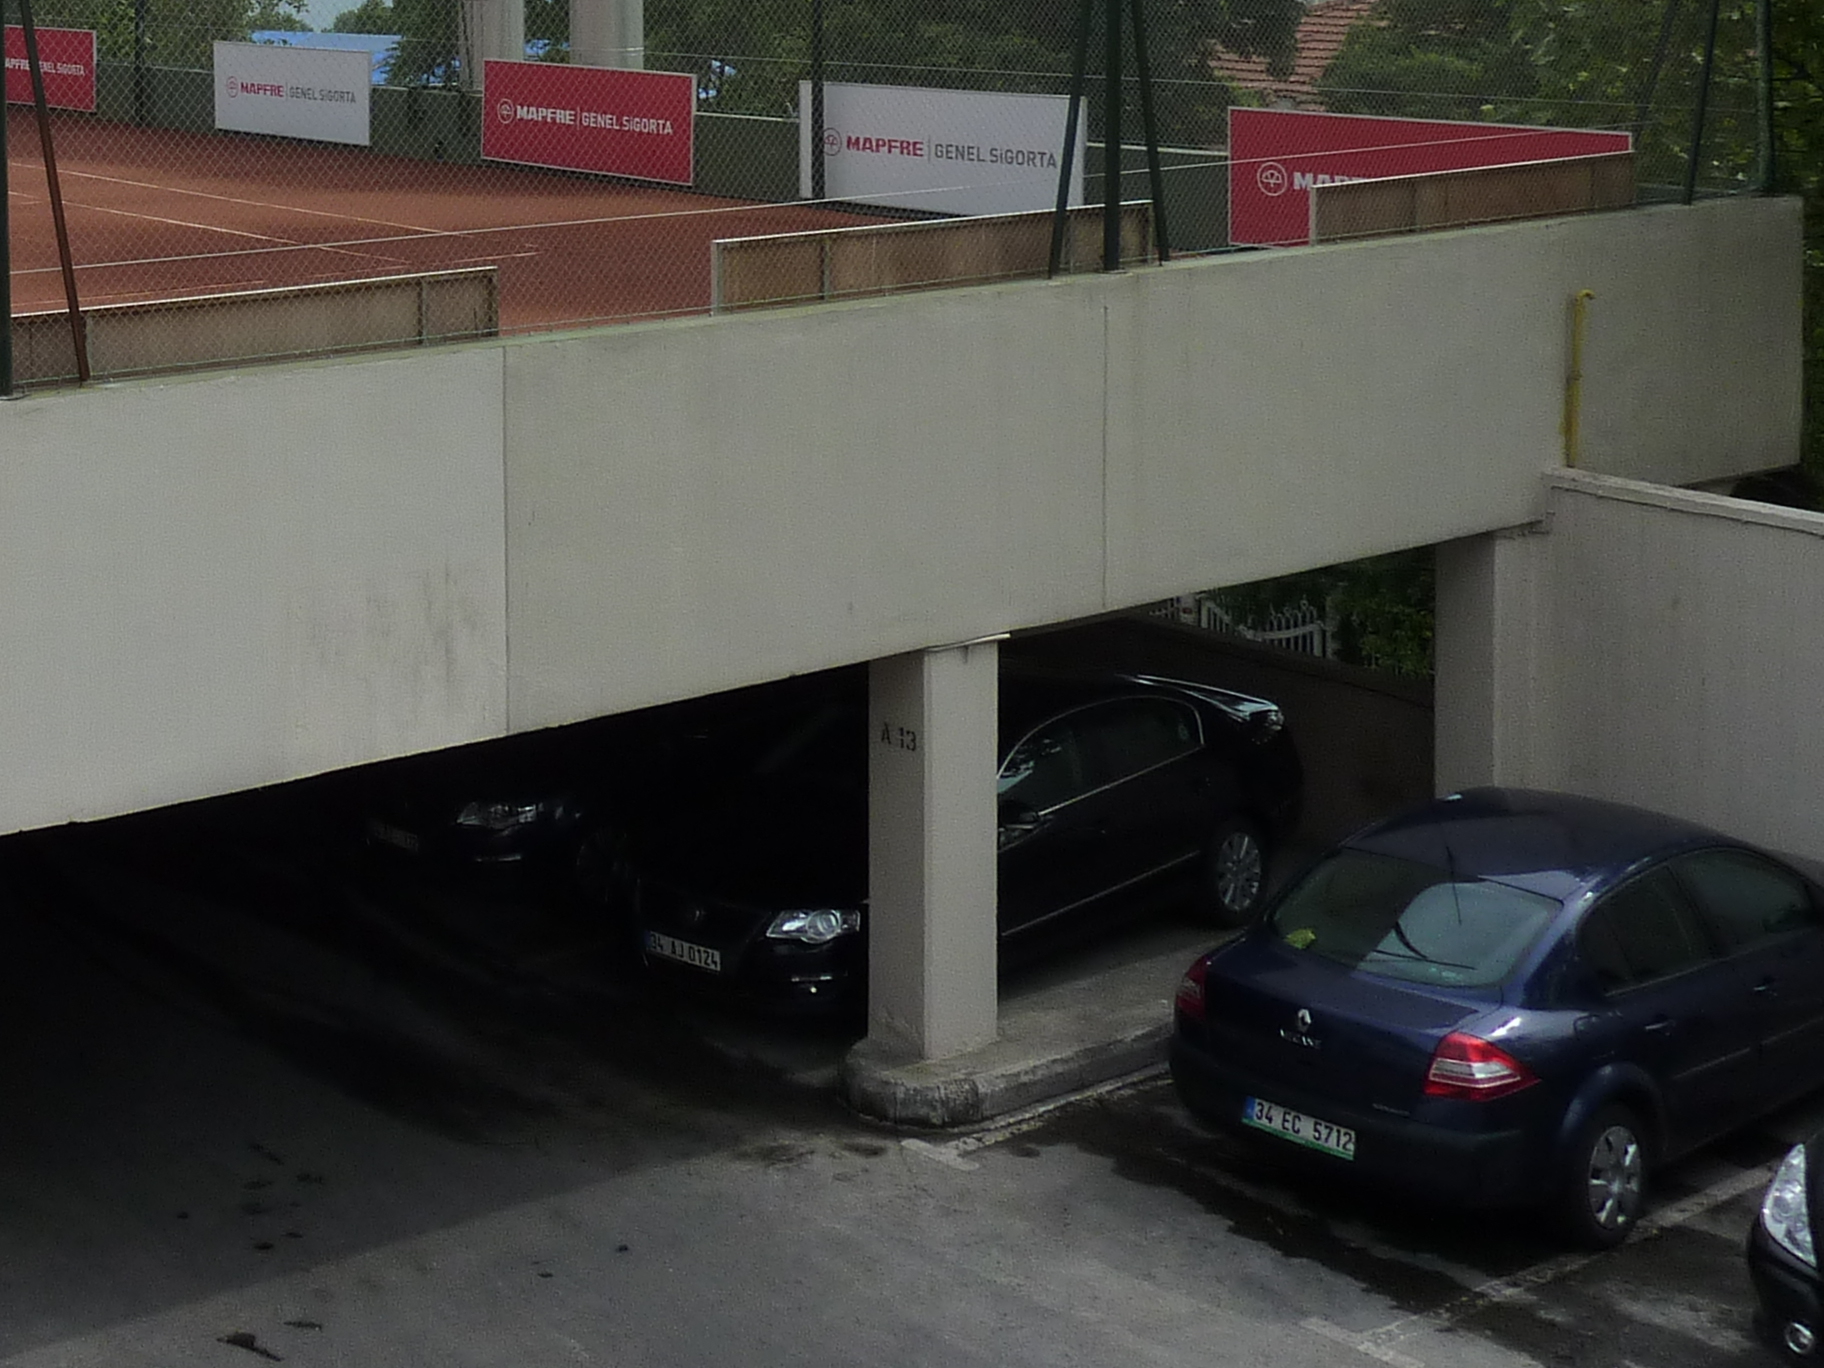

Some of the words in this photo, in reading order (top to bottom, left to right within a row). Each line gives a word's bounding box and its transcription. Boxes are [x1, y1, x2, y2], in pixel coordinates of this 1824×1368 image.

[240, 81, 284, 98] MAPFRE
[289, 86, 318, 101] GENEL
[516, 105, 575, 125] MAPFRE
[581, 112, 620, 130] GENEL
[846, 136, 924, 158] MAPFRE
[934, 143, 985, 163] GENEL
[899, 727, 916, 751] 13
[651, 933, 663, 951] 34
[688, 945, 719, 969] 0124
[1255, 1101, 1273, 1124] 34
[1281, 1111, 1302, 1135] EC
[1312, 1120, 1353, 1151] 5712
